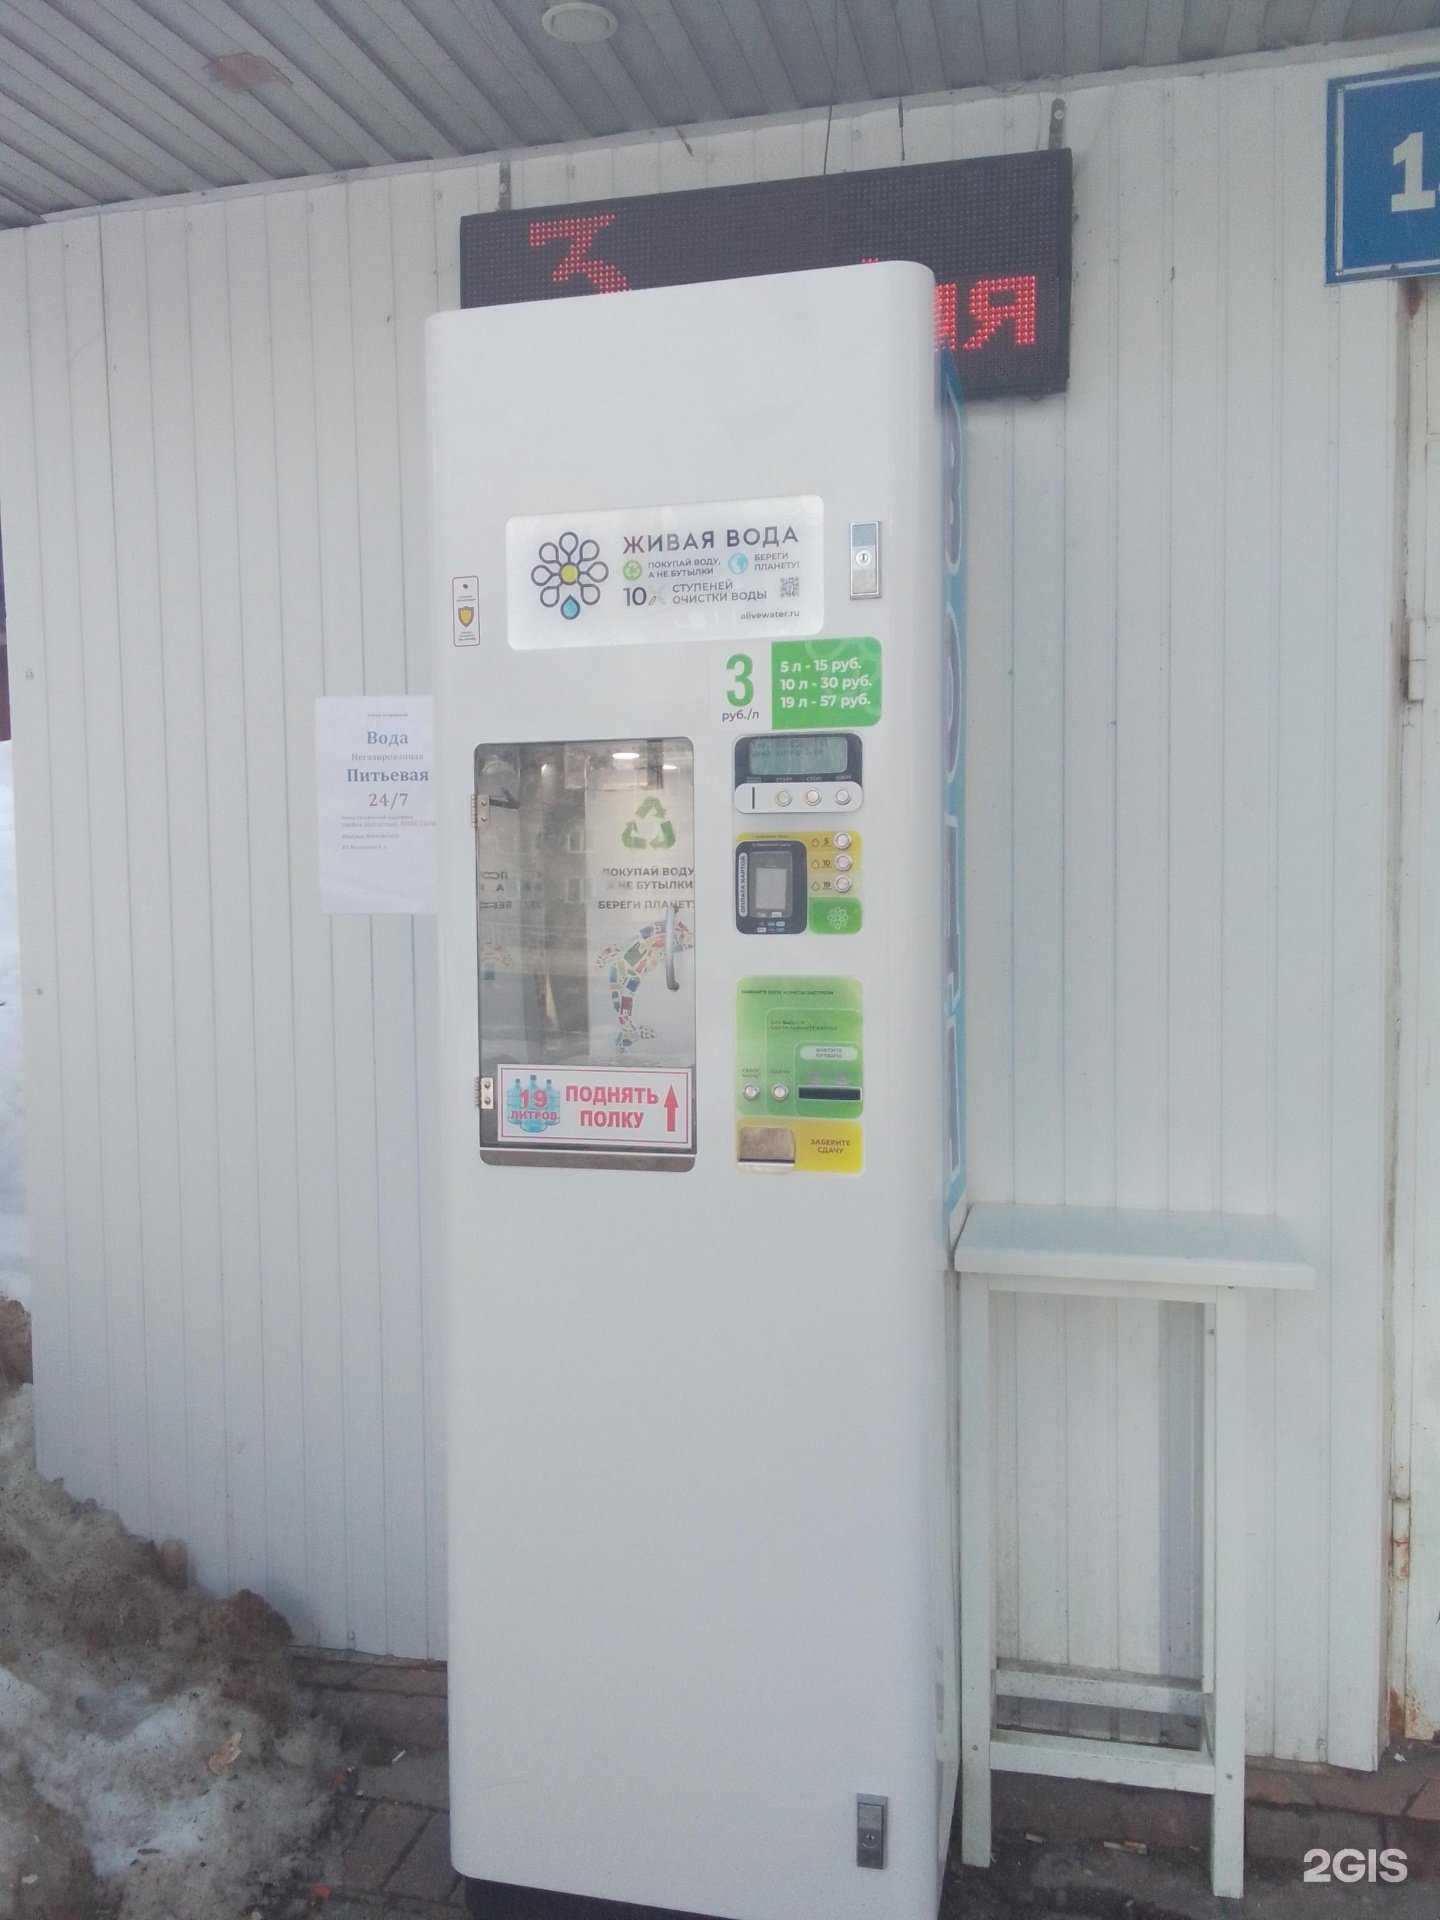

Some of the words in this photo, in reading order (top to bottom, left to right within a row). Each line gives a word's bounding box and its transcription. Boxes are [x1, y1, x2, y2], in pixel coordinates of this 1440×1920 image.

[623, 531, 715, 554] ЖИВАЯ
[726, 526, 799, 548] ВОДА
[648, 559, 692, 570] ПОКУПАЙ
[754, 552, 789, 561] БЕРЕГИ
[656, 570, 669, 578] НЕ
[668, 568, 714, 578] БУТЫЛКИ
[672, 580, 734, 593] СТУПЕНЕЙ
[623, 586, 647, 607] 10
[672, 593, 728, 605] ОЧИСТКИ
[731, 590, 768, 602] ВОДЫ
[780, 661, 790, 673] 5
[792, 663, 802, 672] л
[813, 659, 828, 672] 15
[831, 657, 862, 673] руб.
[726, 653, 754, 707] 3
[780, 678, 796, 690] 10
[798, 681, 808, 690] л
[820, 676, 839, 689] 30
[842, 674, 873, 690] руб.
[780, 696, 795, 709] 19
[798, 698, 808, 708] л
[819, 694, 837, 708] 57
[840, 692, 871, 709] руб.
[721, 709, 760, 723] руб./л
[366, 730, 409, 747] Вода
[346, 768, 430, 783] Питьевая
[368, 792, 409, 811] 24/7
[644, 900, 695, 910] ПЛАНЕТ
[520, 1089, 548, 1108] 19
[565, 1085, 659, 1106] ПОДНЯТЬ
[580, 1110, 645, 1129] ПОЛКУ
